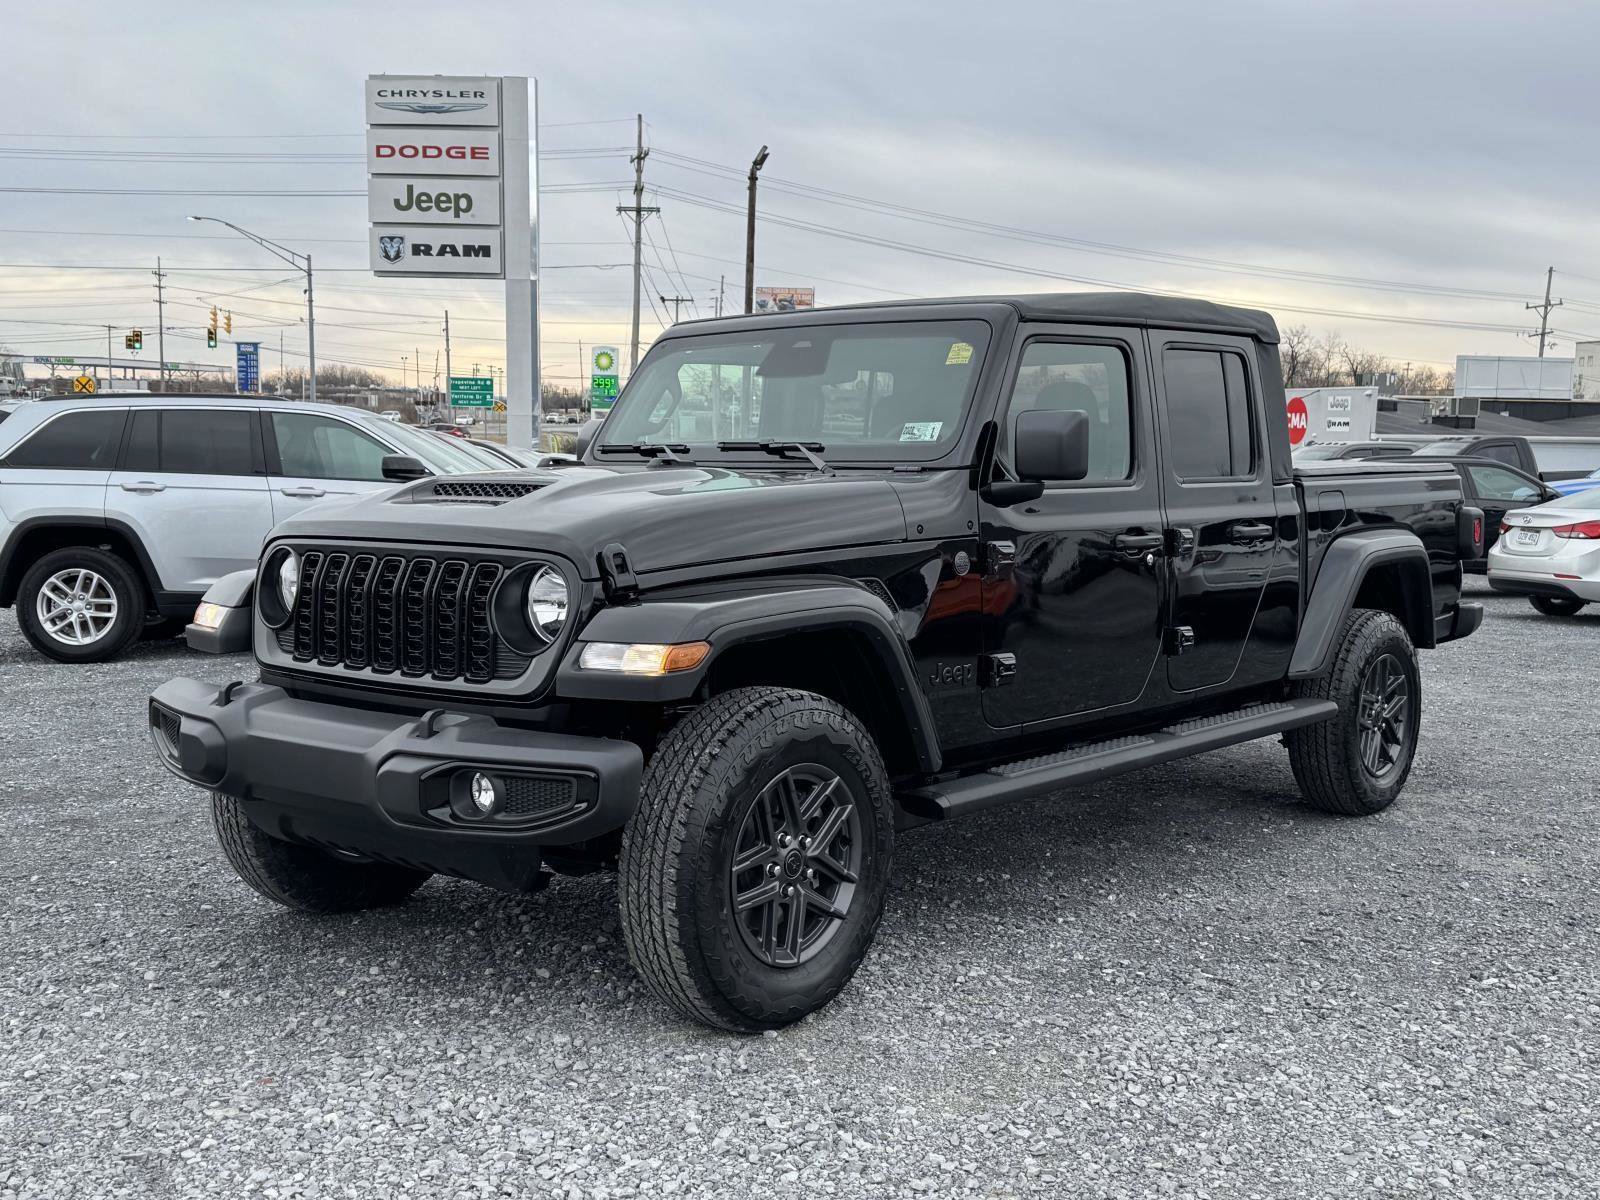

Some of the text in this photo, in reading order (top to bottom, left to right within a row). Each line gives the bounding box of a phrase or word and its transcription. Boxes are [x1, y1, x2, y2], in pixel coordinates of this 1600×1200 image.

[376, 89, 486, 99] CHRYSLER
[375, 144, 490, 160] DODGE
[393, 184, 473, 219] Jeep
[411, 243, 491, 258] RAM
[1330, 396, 1349, 411] Jeep
[929, 662, 972, 687] Jeep
